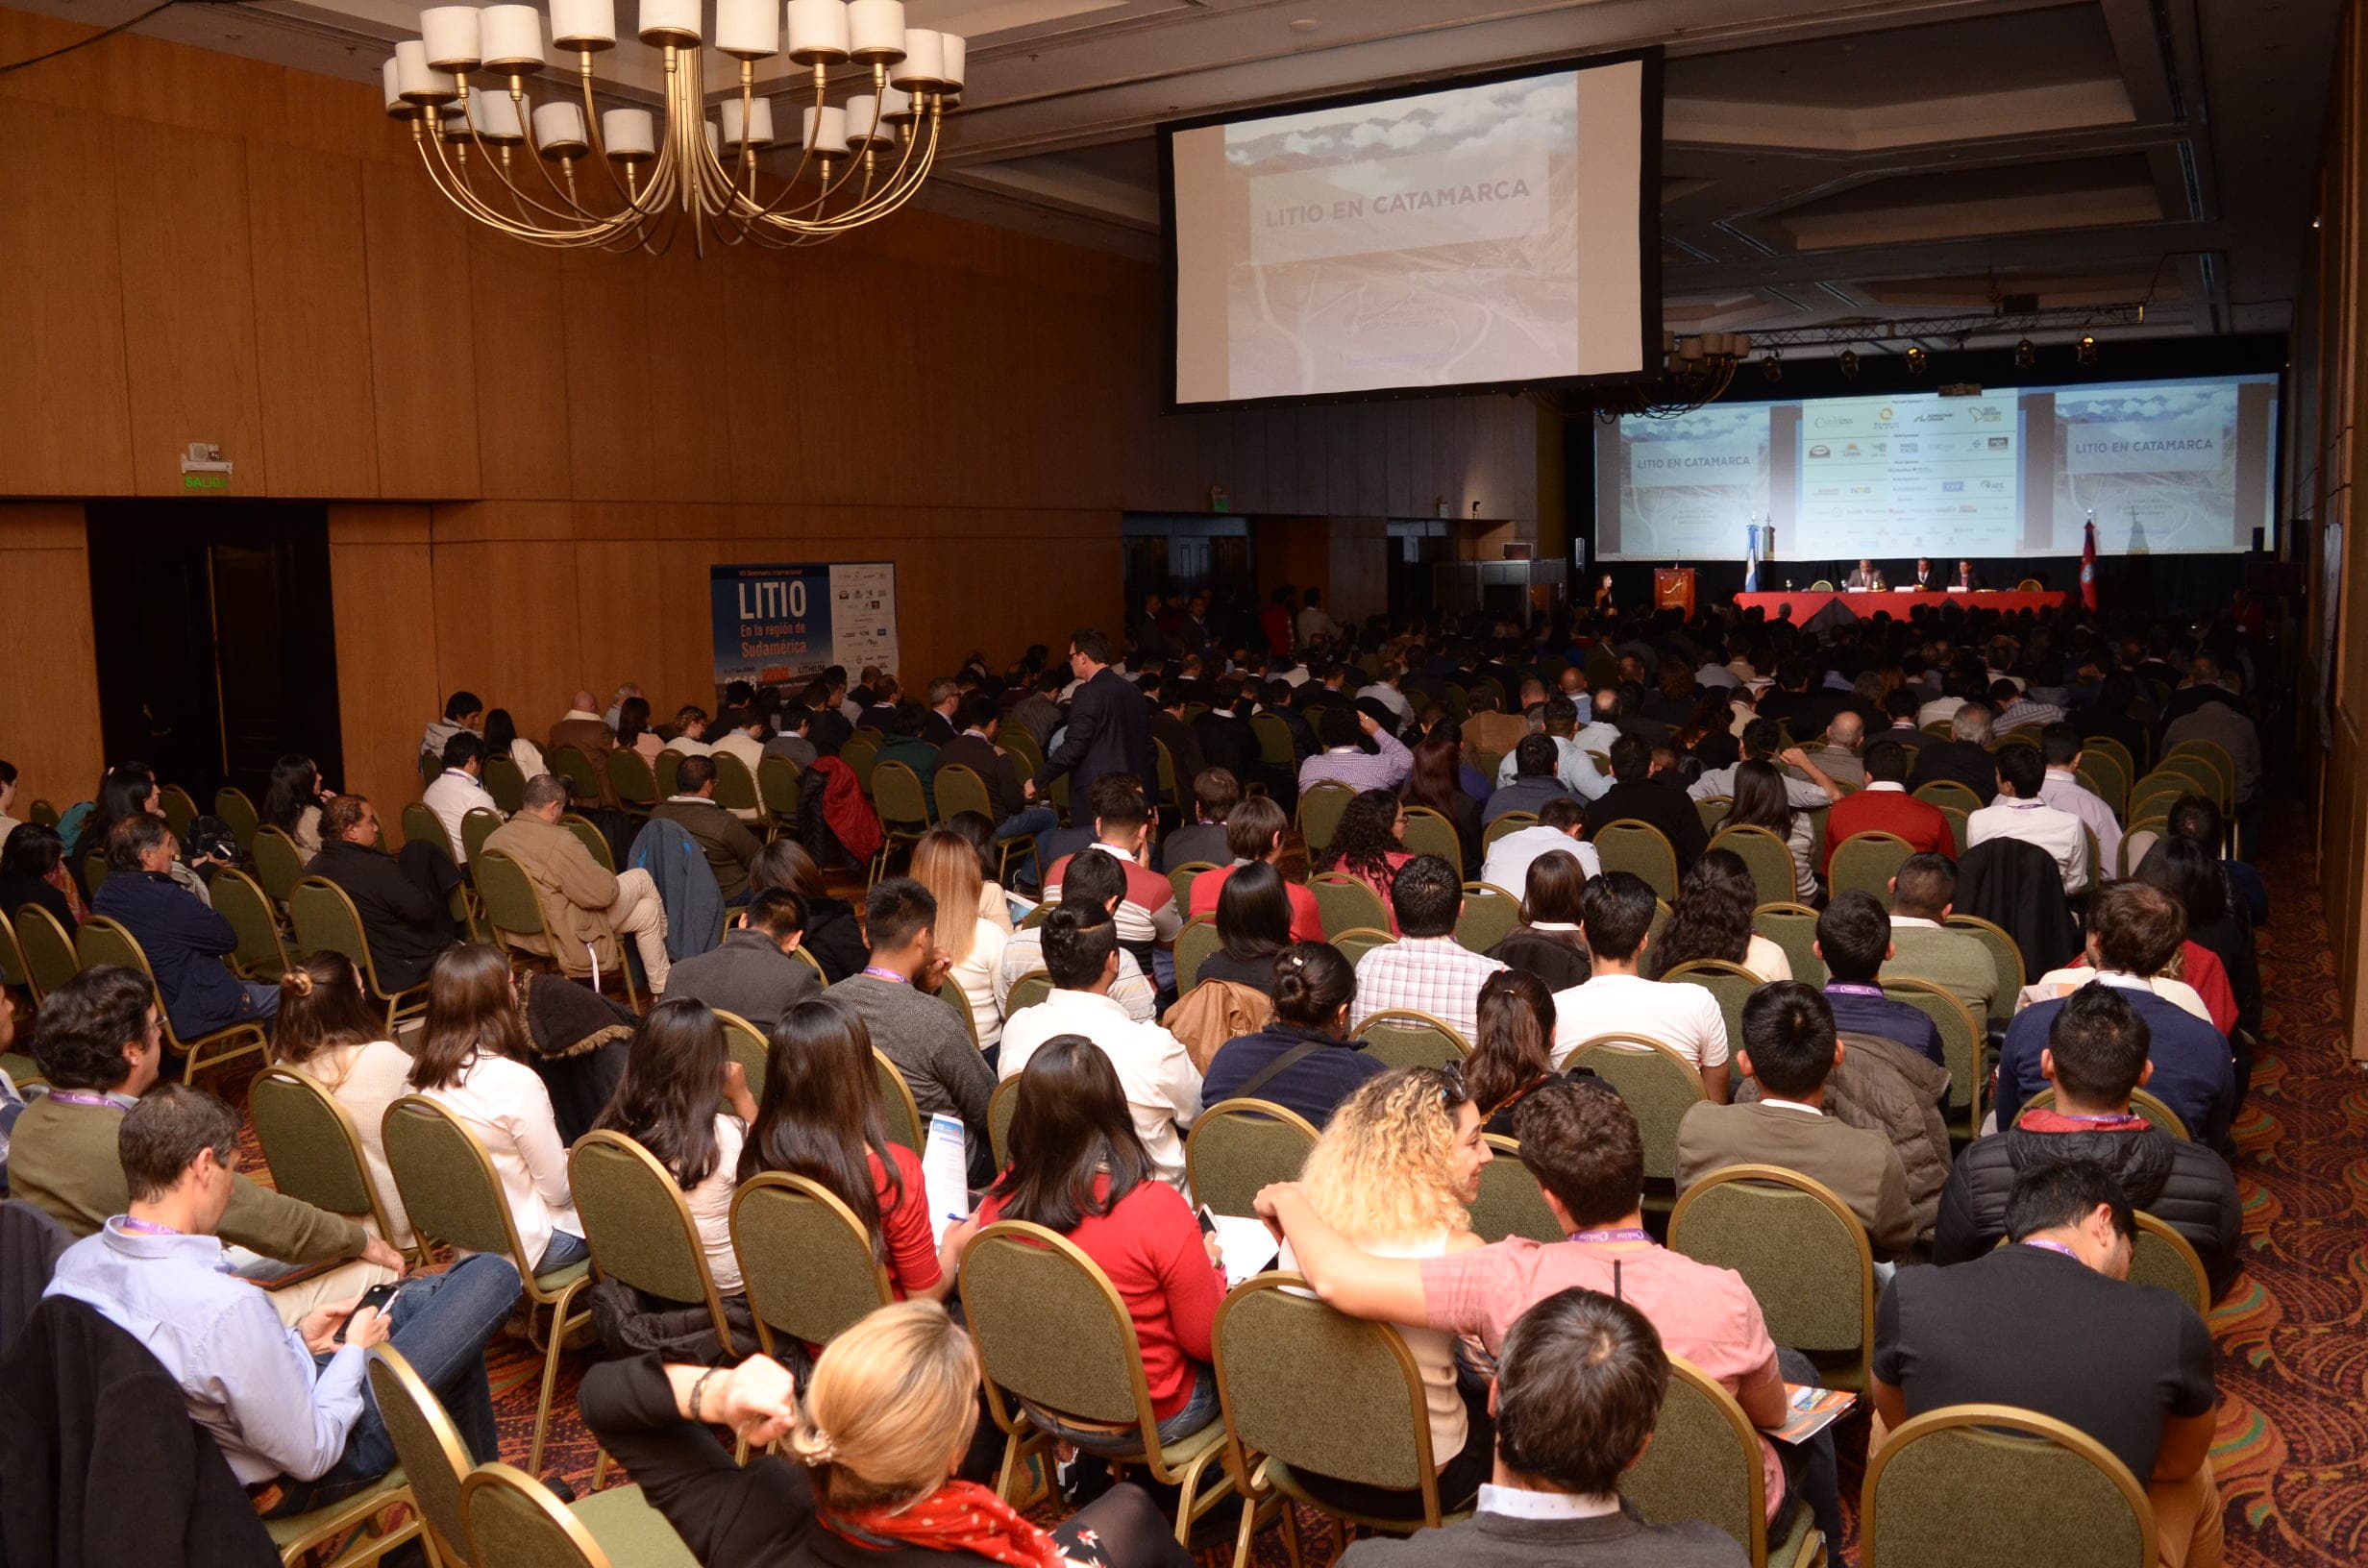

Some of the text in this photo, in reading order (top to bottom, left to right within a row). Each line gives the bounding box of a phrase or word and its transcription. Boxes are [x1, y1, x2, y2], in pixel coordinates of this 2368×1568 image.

[1265, 179, 1531, 229] LITIO EN CATAMARCA
[2075, 438, 2213, 454] LITIO EN CATAMARCA
[1638, 455, 1751, 470] LITIO EN CATAMARCA
[185, 476, 230, 488] SALIDA
[738, 579, 806, 620] LITIO
[740, 621, 806, 638] En la región de
[741, 639, 807, 658] Sudamérica
